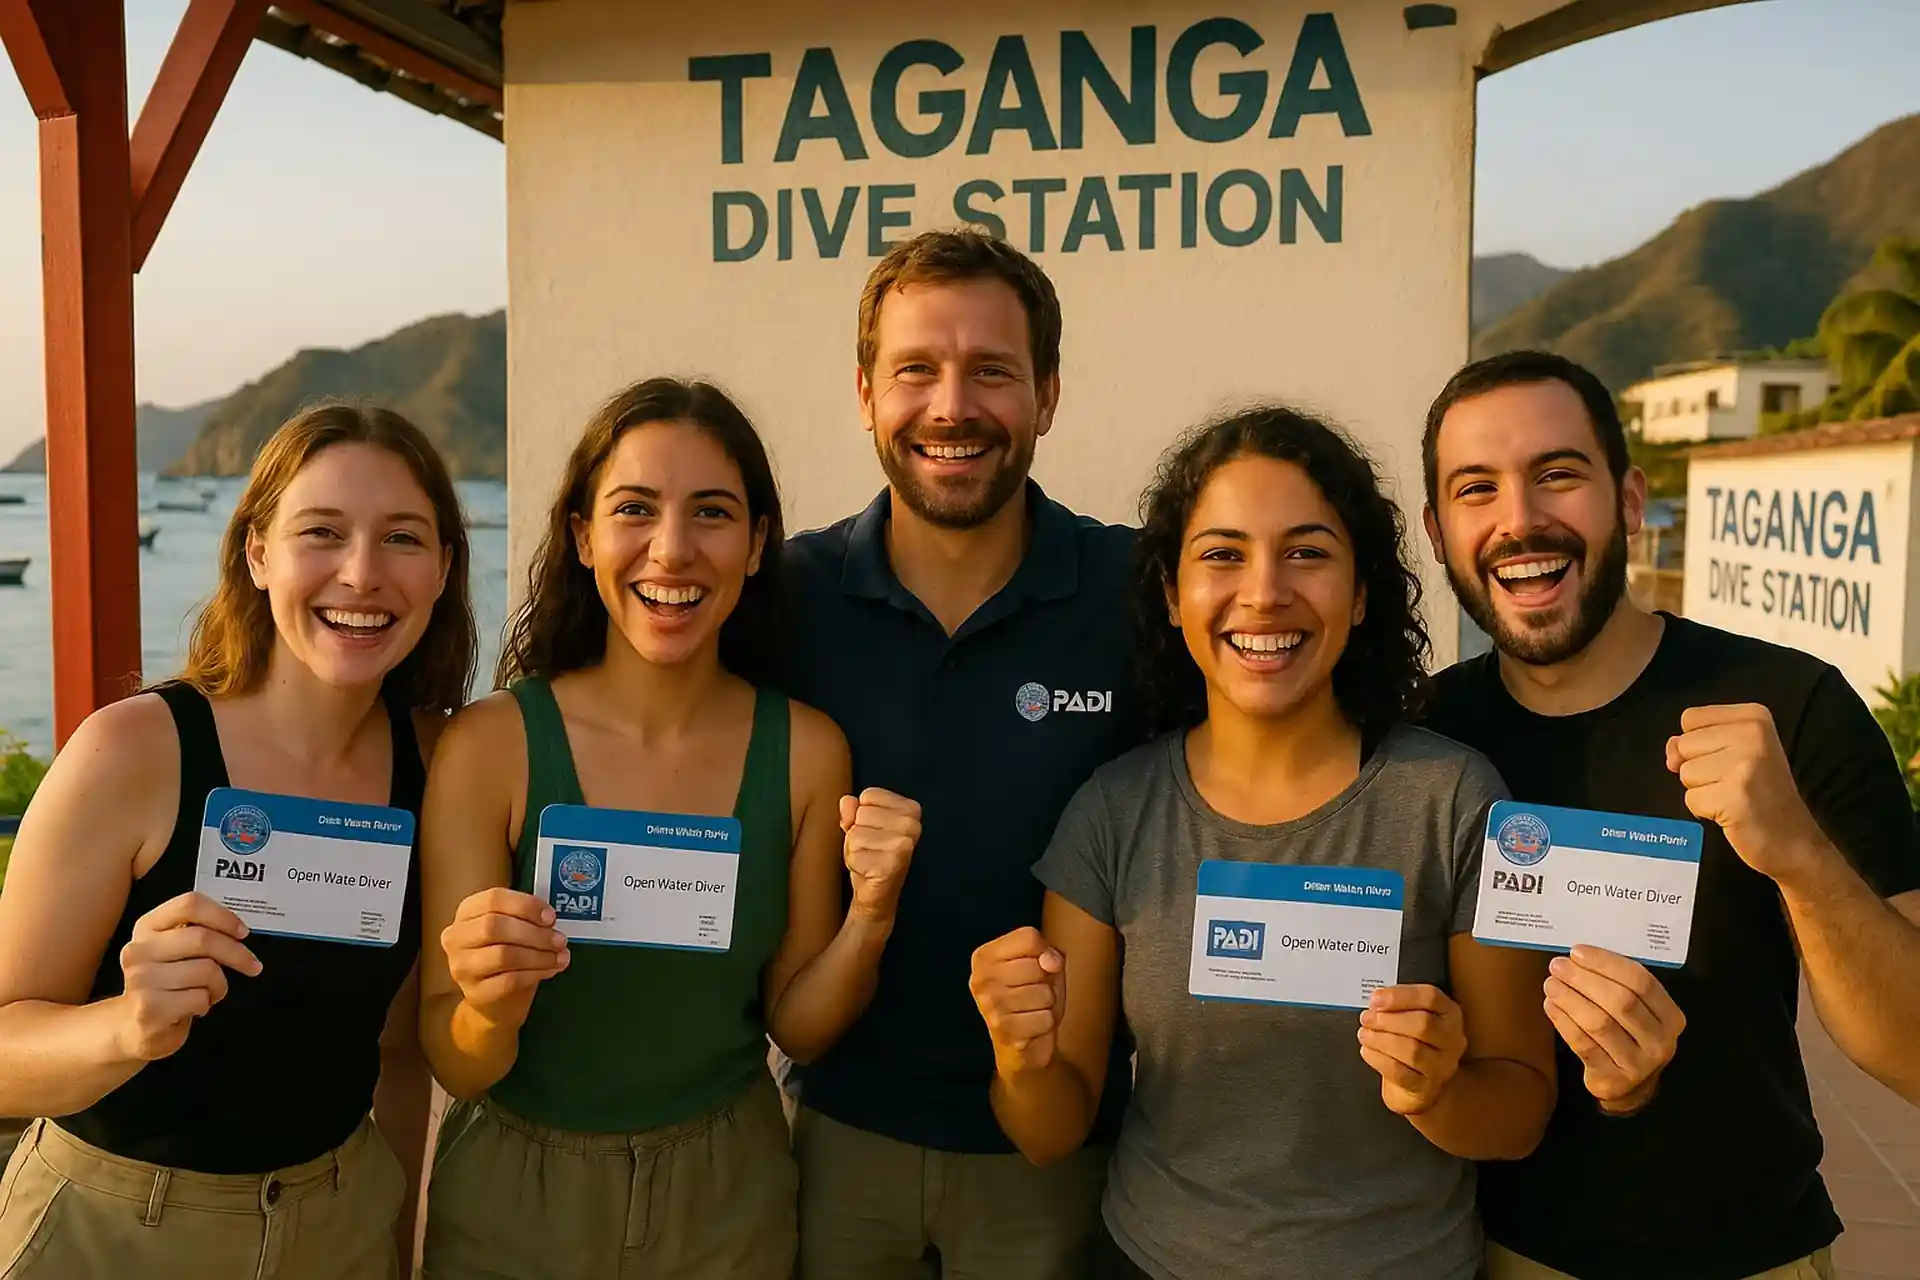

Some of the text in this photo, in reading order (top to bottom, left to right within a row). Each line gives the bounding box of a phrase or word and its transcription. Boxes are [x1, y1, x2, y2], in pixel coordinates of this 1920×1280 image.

[688, 13, 1371, 164] TAGANGA
[712, 165, 1344, 262] DIVE STATION
[1706, 487, 1881, 564] TAGANGA
[1762, 569, 1871, 637] STATION
[1053, 690, 1112, 712] PADI
[287, 868, 392, 890] Open Wate Diver
[624, 876, 726, 894] Open Water Diver
[1492, 870, 1544, 895] PADI
[556, 893, 598, 915] PADI
[1567, 880, 1682, 905] Open Water Diver
[1213, 927, 1260, 950] PADI
[1281, 935, 1391, 955] Open Water Diver
